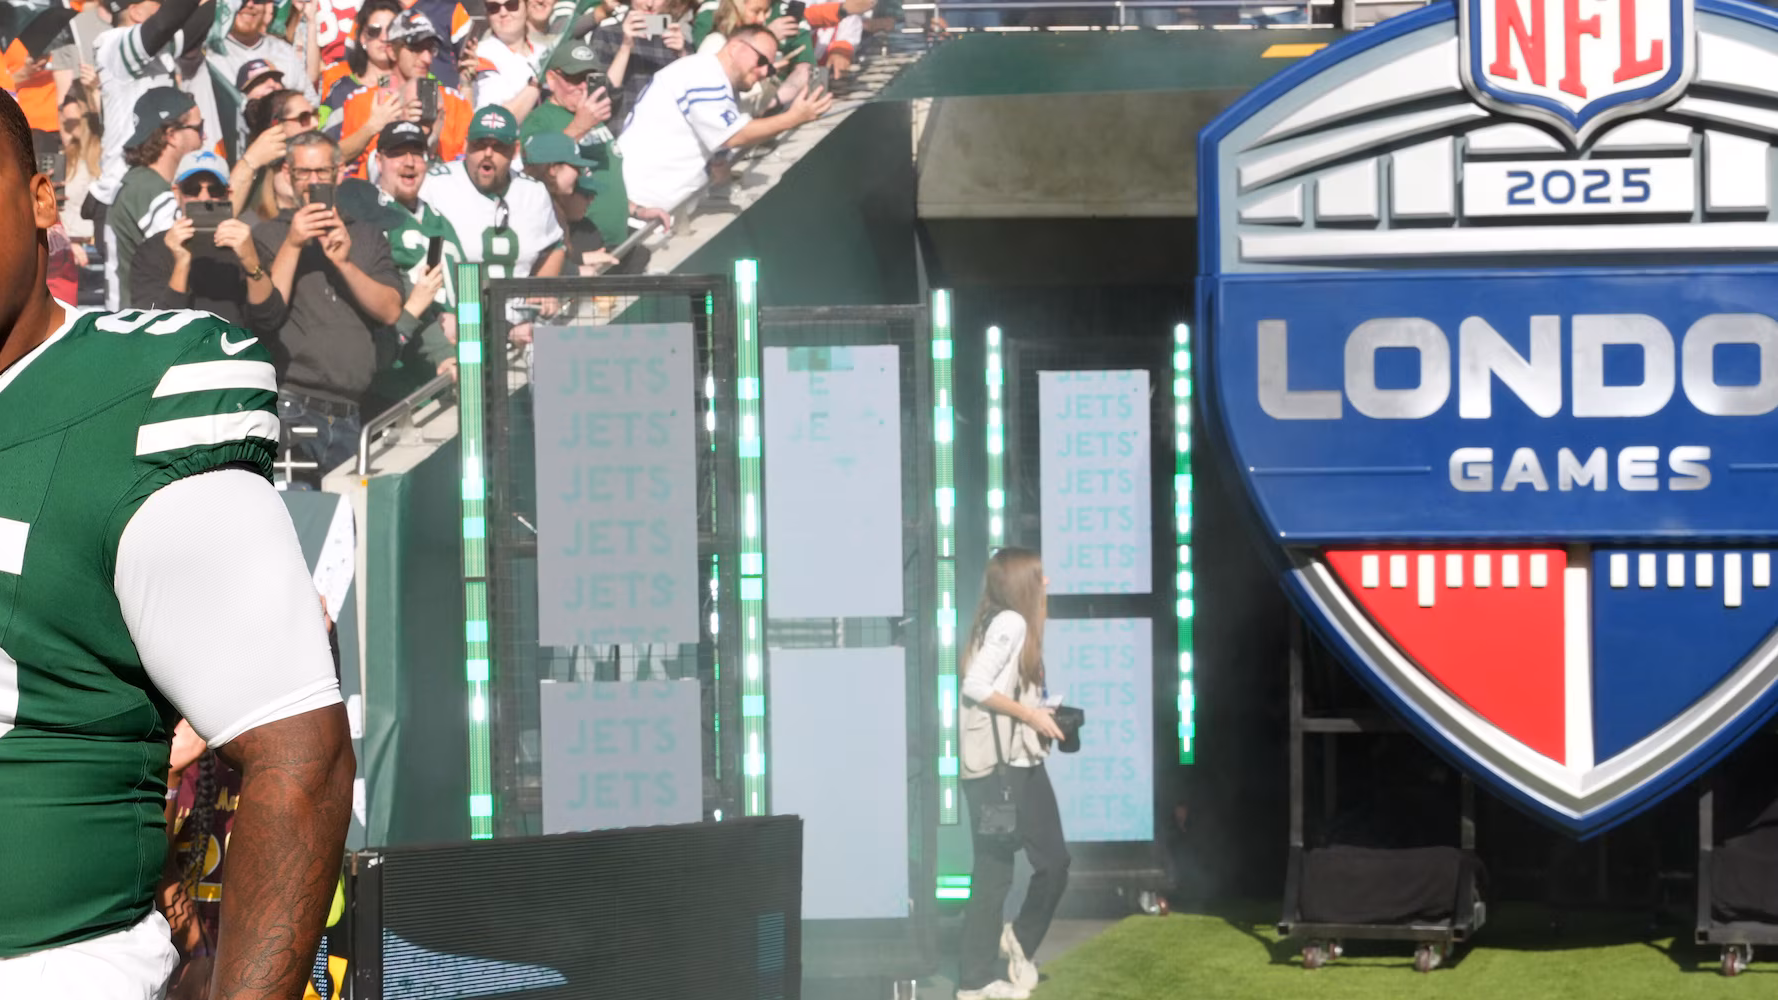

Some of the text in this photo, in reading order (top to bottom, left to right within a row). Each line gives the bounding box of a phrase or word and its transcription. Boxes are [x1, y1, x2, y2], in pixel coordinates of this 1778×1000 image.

[1489, 0, 1663, 99] NFL
[1505, 167, 1652, 206] 2025
[481, 225, 520, 278] 8
[559, 357, 670, 396] JETS
[1056, 394, 1134, 420] JETS
[559, 411, 671, 449] JETS
[1057, 431, 1135, 458] JETS
[561, 464, 672, 503] JETS
[1057, 469, 1135, 495] JETS
[1448, 445, 1712, 492] GAMES
[562, 518, 672, 557] JETS
[1058, 505, 1135, 533] JETS
[1059, 543, 1136, 570] JETS
[563, 572, 675, 611] JETS
[1060, 644, 1136, 671] JETS
[567, 714, 678, 755] JETS
[567, 770, 679, 810] JETS
